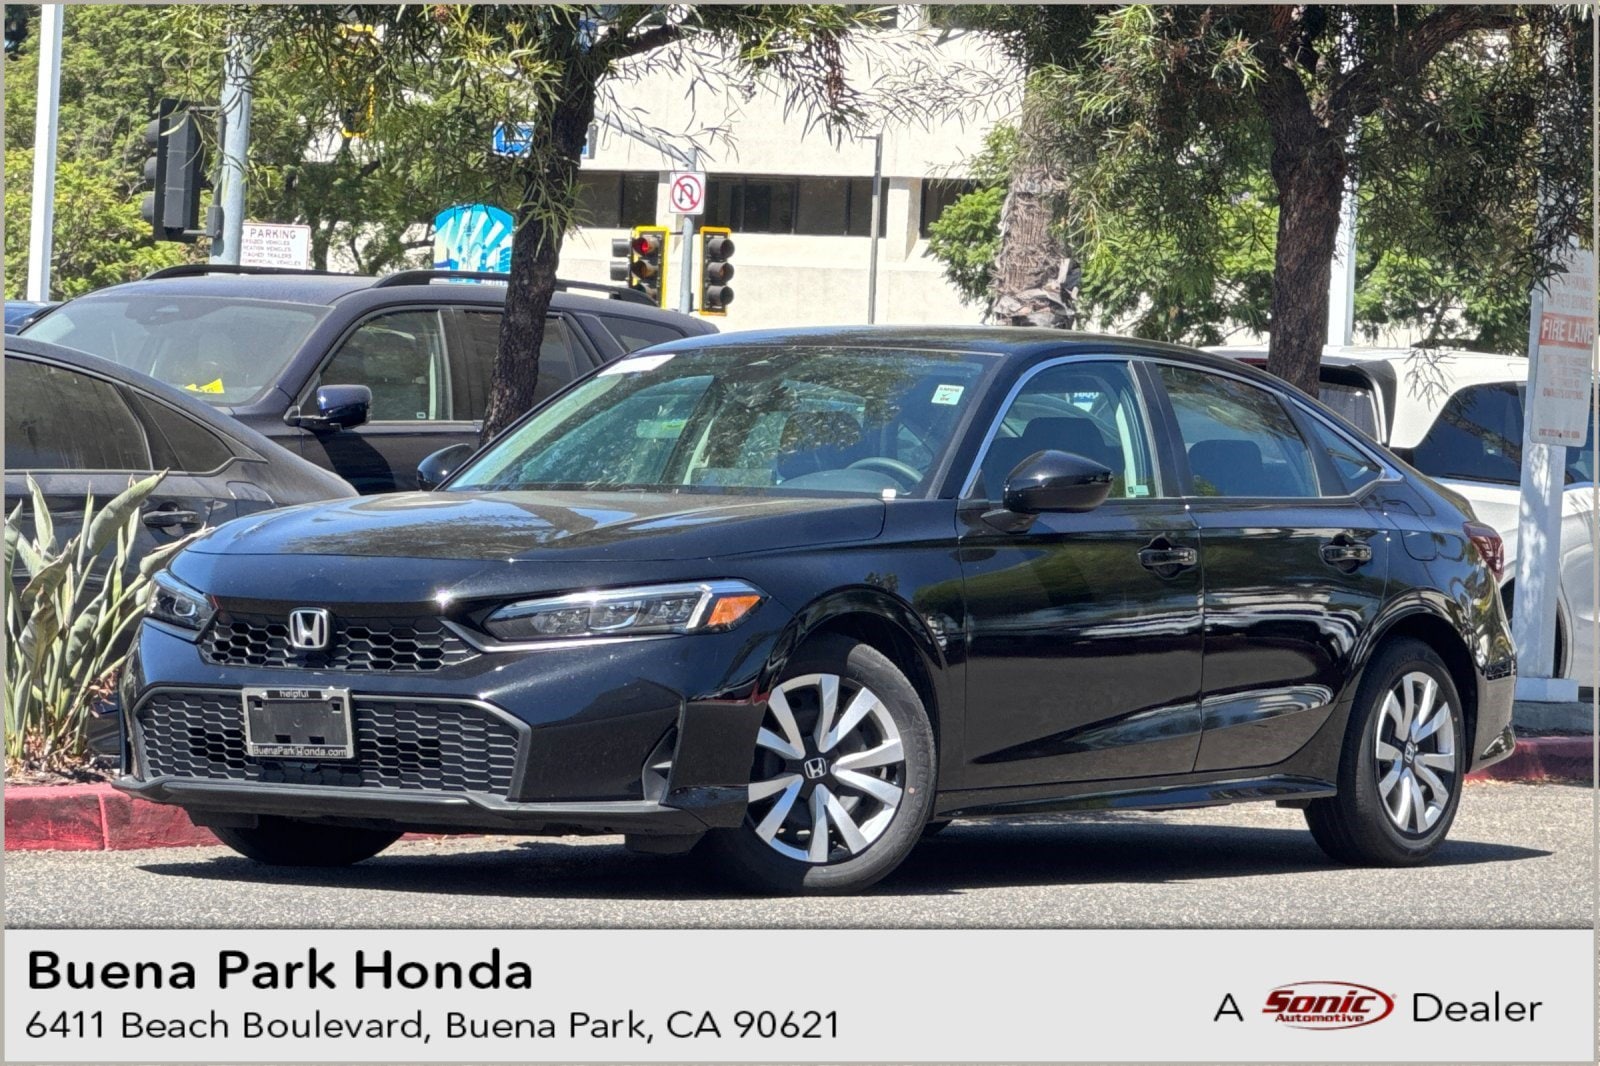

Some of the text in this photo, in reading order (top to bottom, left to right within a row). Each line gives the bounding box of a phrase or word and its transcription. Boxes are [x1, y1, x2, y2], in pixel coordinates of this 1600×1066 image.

[250, 228, 296, 239] PARKING
[1541, 318, 1593, 344] FIRE LANE
[279, 690, 309, 698] helpful
